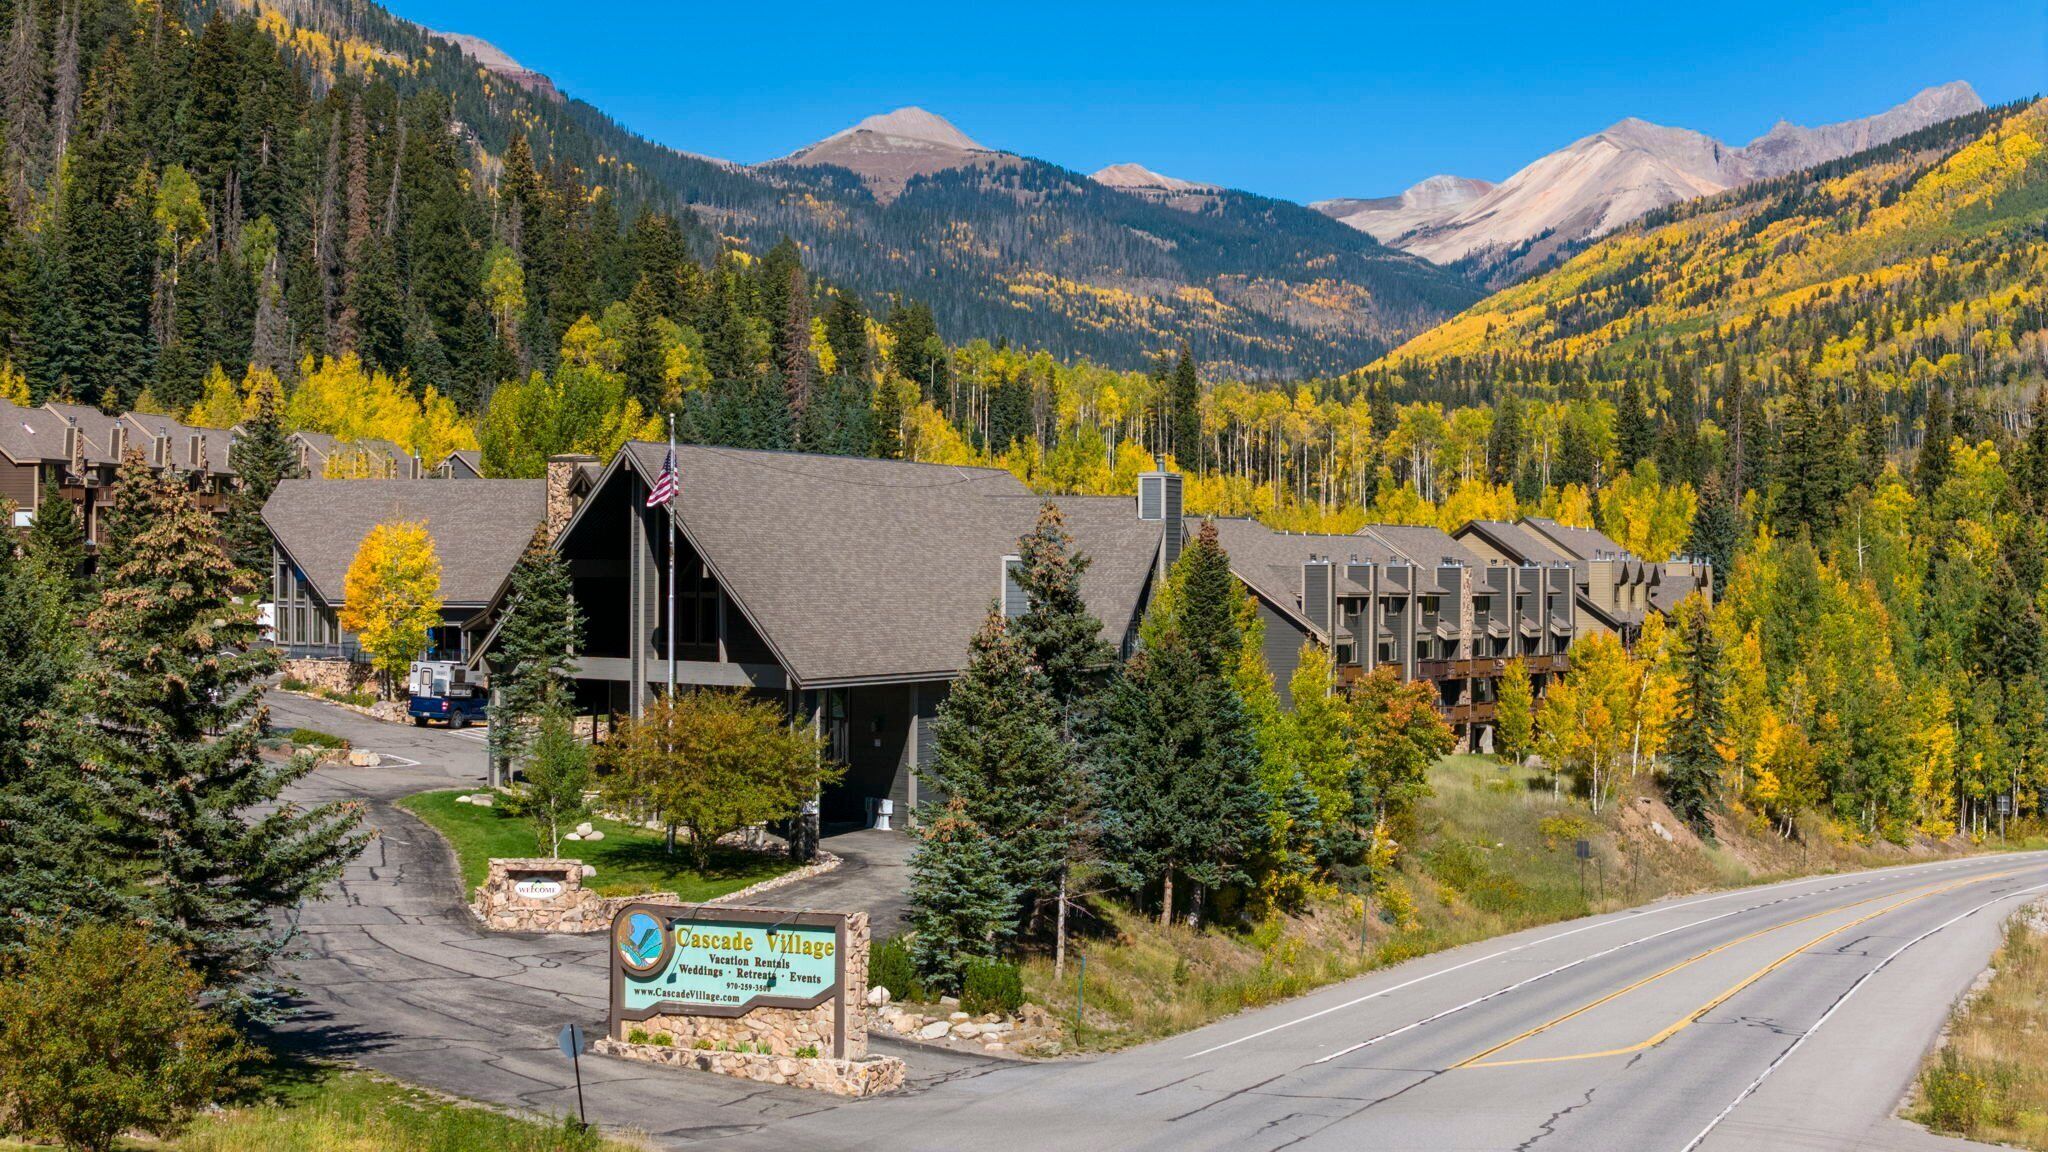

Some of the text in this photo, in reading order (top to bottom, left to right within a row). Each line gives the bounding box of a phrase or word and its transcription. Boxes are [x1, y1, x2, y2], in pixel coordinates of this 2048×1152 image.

[518, 884, 557, 894] WELCOME
[676, 927, 835, 960] Cascade Village
[709, 954, 791, 970] Vacation Rentals
[679, 964, 822, 985] Weddings Retreats Events
[633, 988, 740, 1003] www.CascadeVillage.com
